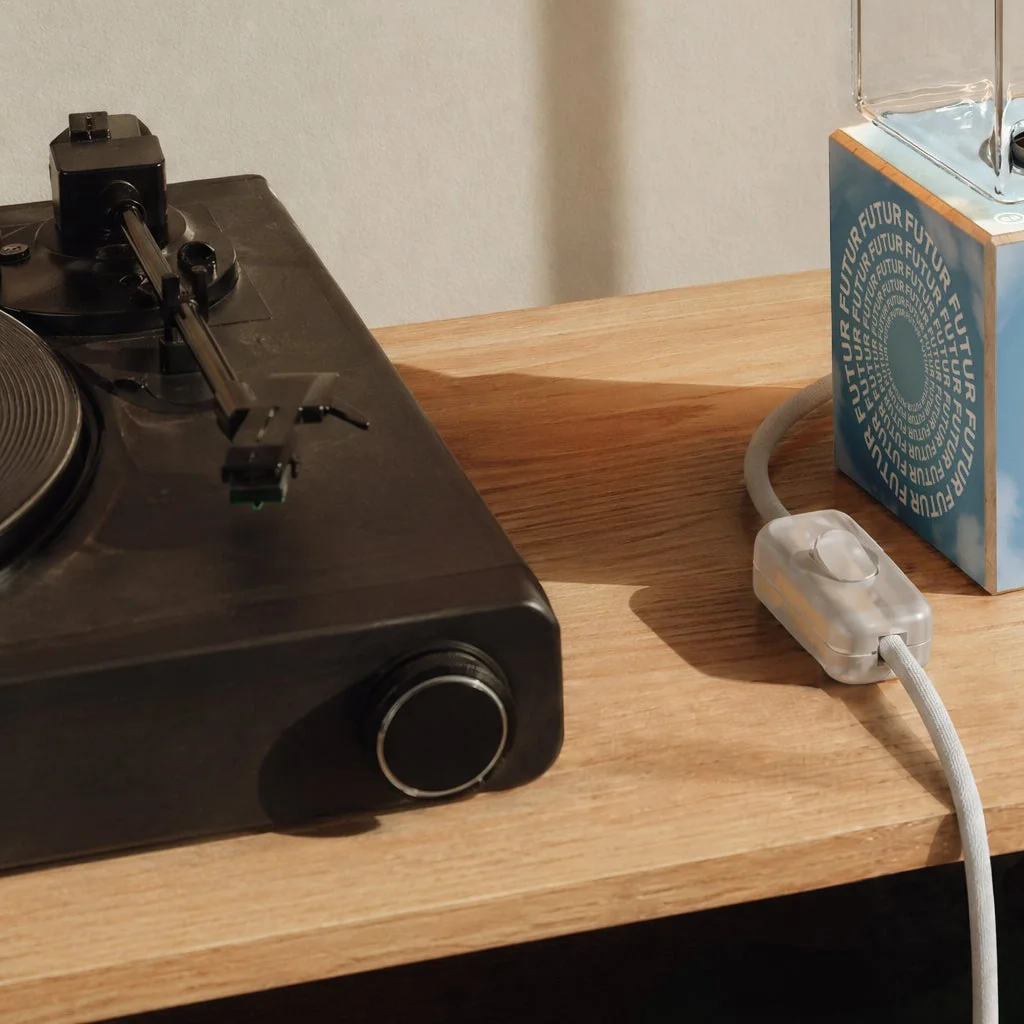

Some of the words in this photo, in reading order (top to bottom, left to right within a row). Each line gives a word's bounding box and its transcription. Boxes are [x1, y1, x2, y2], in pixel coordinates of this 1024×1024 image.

[858, 201, 902, 237] FUTUR
[868, 233, 903, 261] FUTUR
[905, 209, 951, 293] FUTUR
[840, 226, 862, 314] FUTUR
[853, 252, 871, 323] FUTUR
[863, 274, 879, 329] FUTUR
[876, 259, 904, 280] FUTUR
[905, 241, 941, 306] FUTUR
[905, 265, 935, 316] FUTUR
[840, 320, 866, 424] FUTUR
[853, 327, 873, 411] FUTUR
[863, 333, 880, 401] FUTUR
[933, 318, 951, 388] FUTUR
[940, 308, 962, 394] FUTUR
[948, 293, 976, 403] FUTUR
[872, 412, 907, 476] FUTUR
[879, 402, 907, 453] FUTUR
[908, 440, 937, 461] FUTUR
[935, 391, 951, 446] FUTUR
[942, 398, 962, 469] FUTUR
[864, 425, 907, 506] FUTUR
[909, 460, 945, 486] FUTUR
[951, 408, 976, 496] FUTUR
[910, 485, 955, 517] FUTUR
